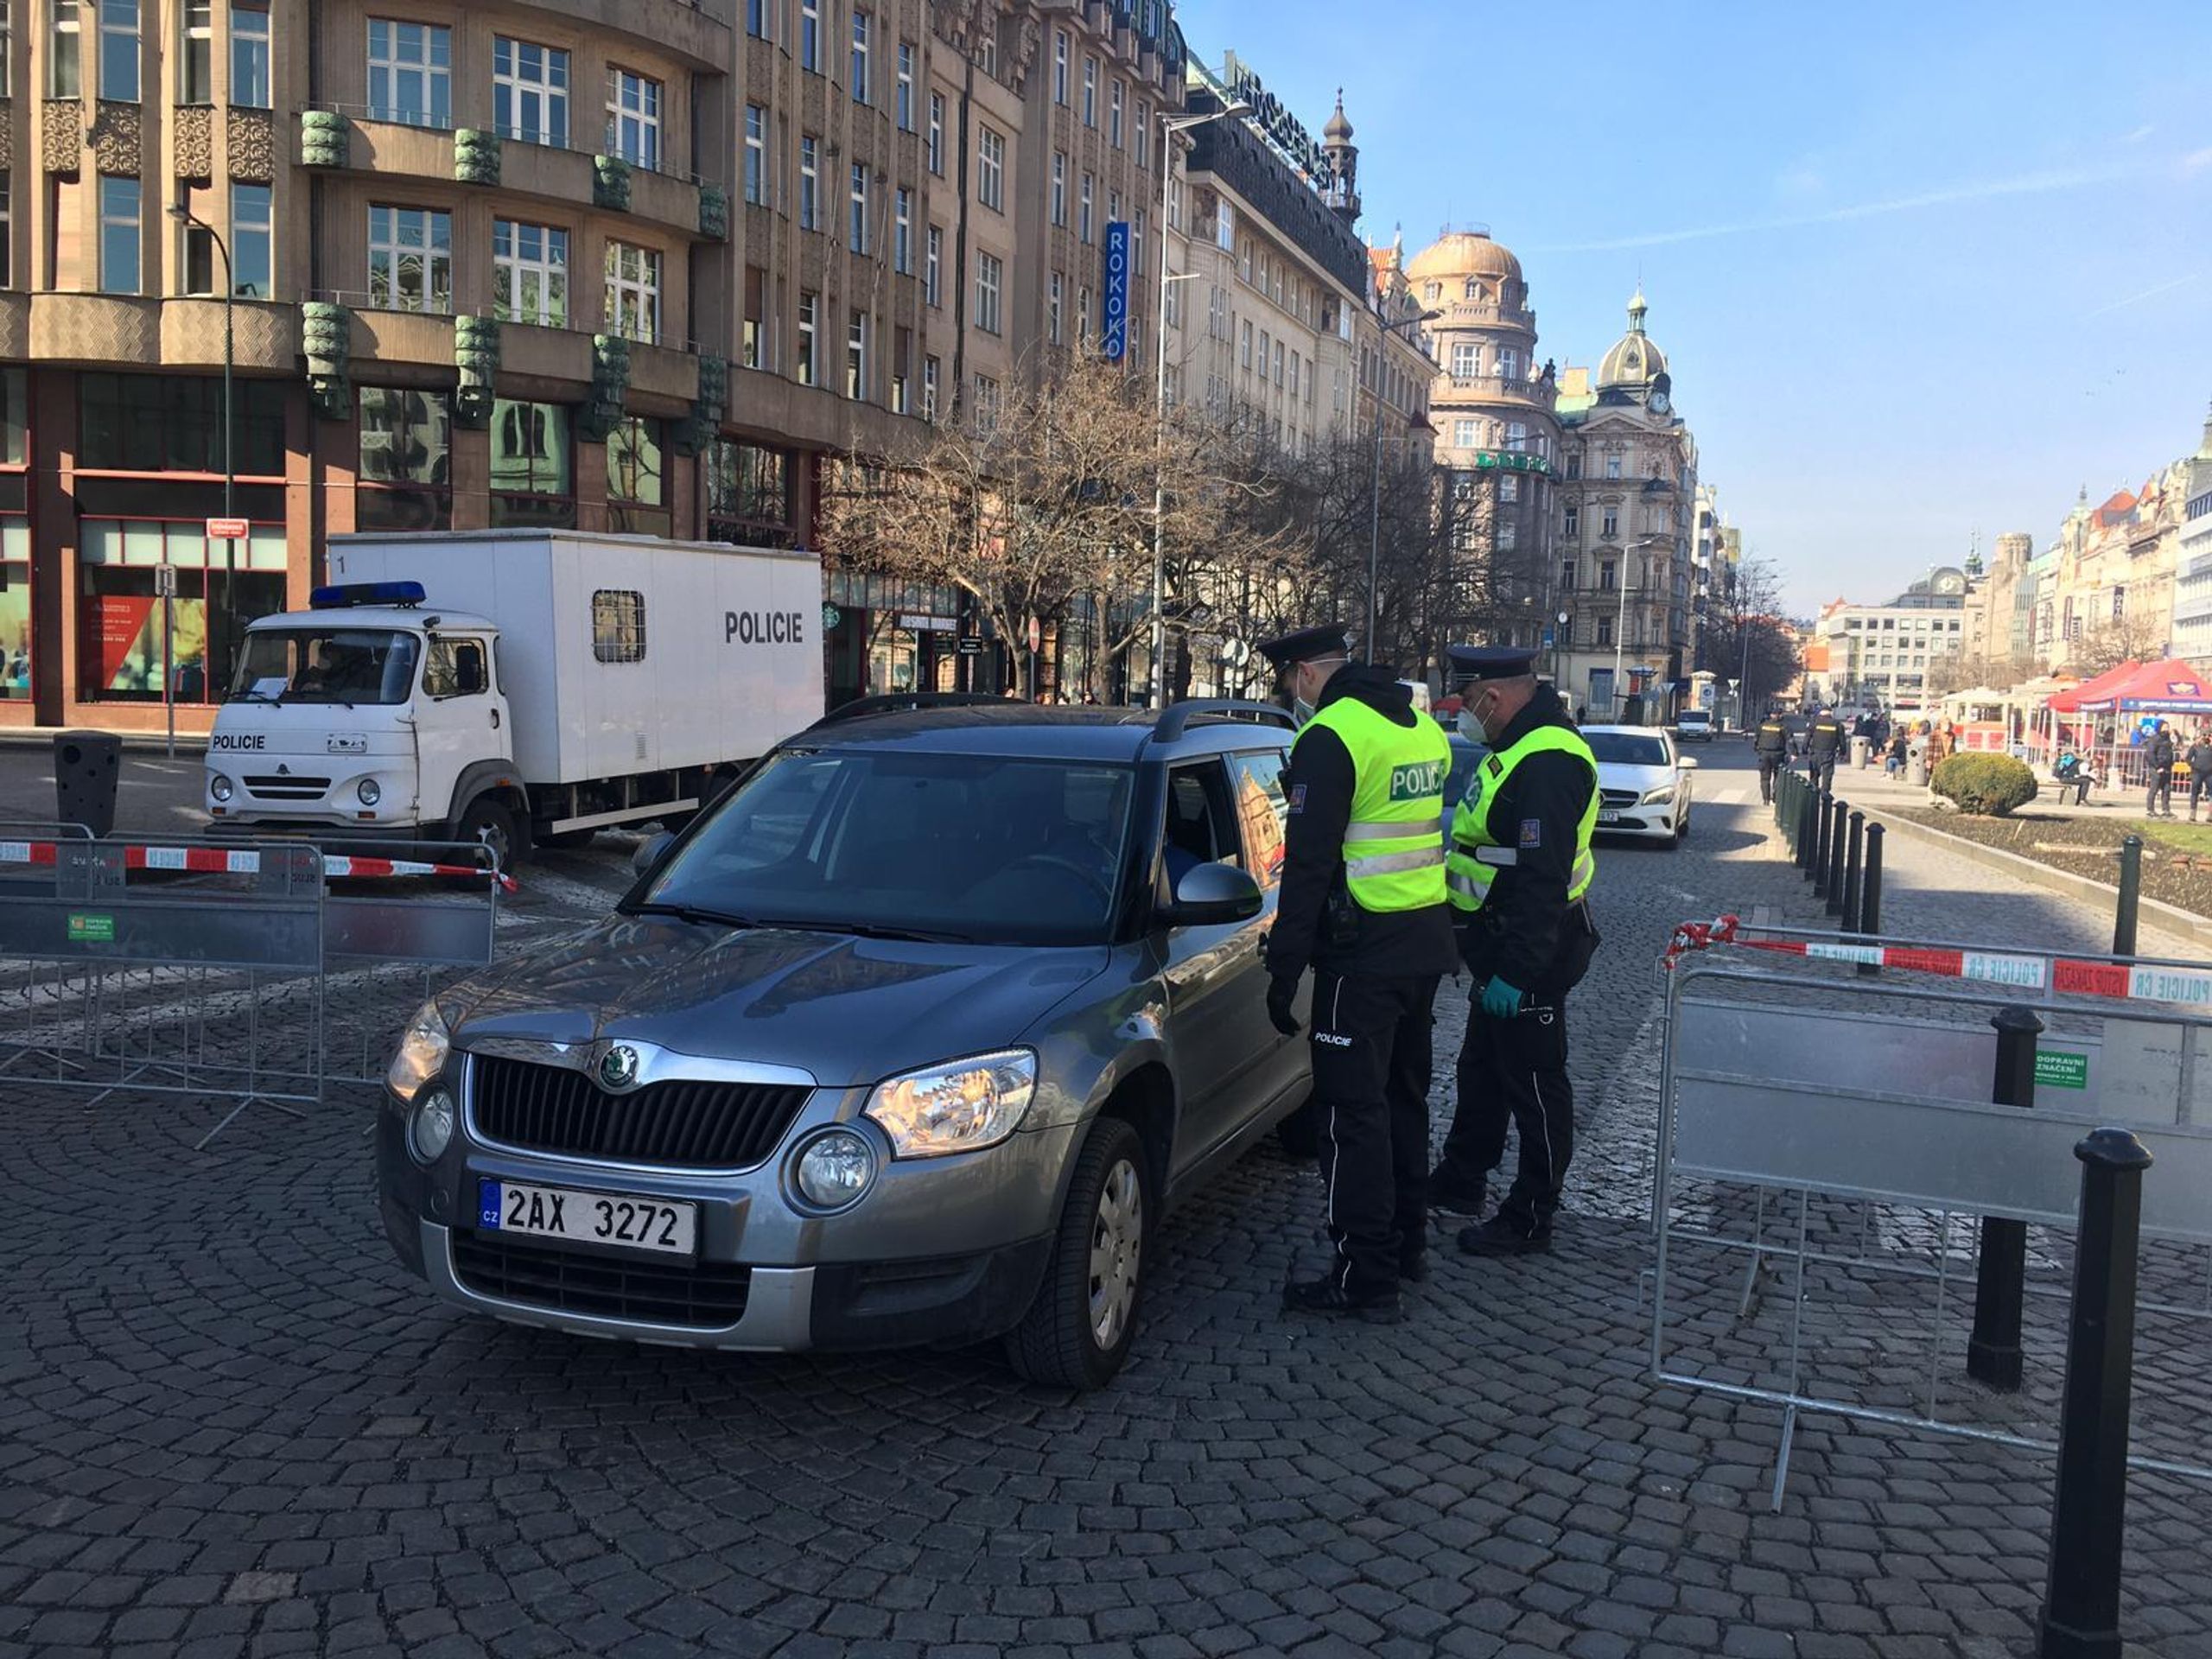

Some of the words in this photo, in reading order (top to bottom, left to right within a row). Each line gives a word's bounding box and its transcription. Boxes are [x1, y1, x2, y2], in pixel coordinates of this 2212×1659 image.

[1107, 232, 1123, 358] ROKOKO
[337, 556, 345, 574] 1
[725, 611, 803, 644] POLICIE
[213, 735, 265, 749] POLICIE
[1315, 1032, 1352, 1046] POLICIE
[482, 1211, 499, 1223] CZ
[506, 1189, 565, 1232] 2AX
[594, 1200, 678, 1246] 3272
